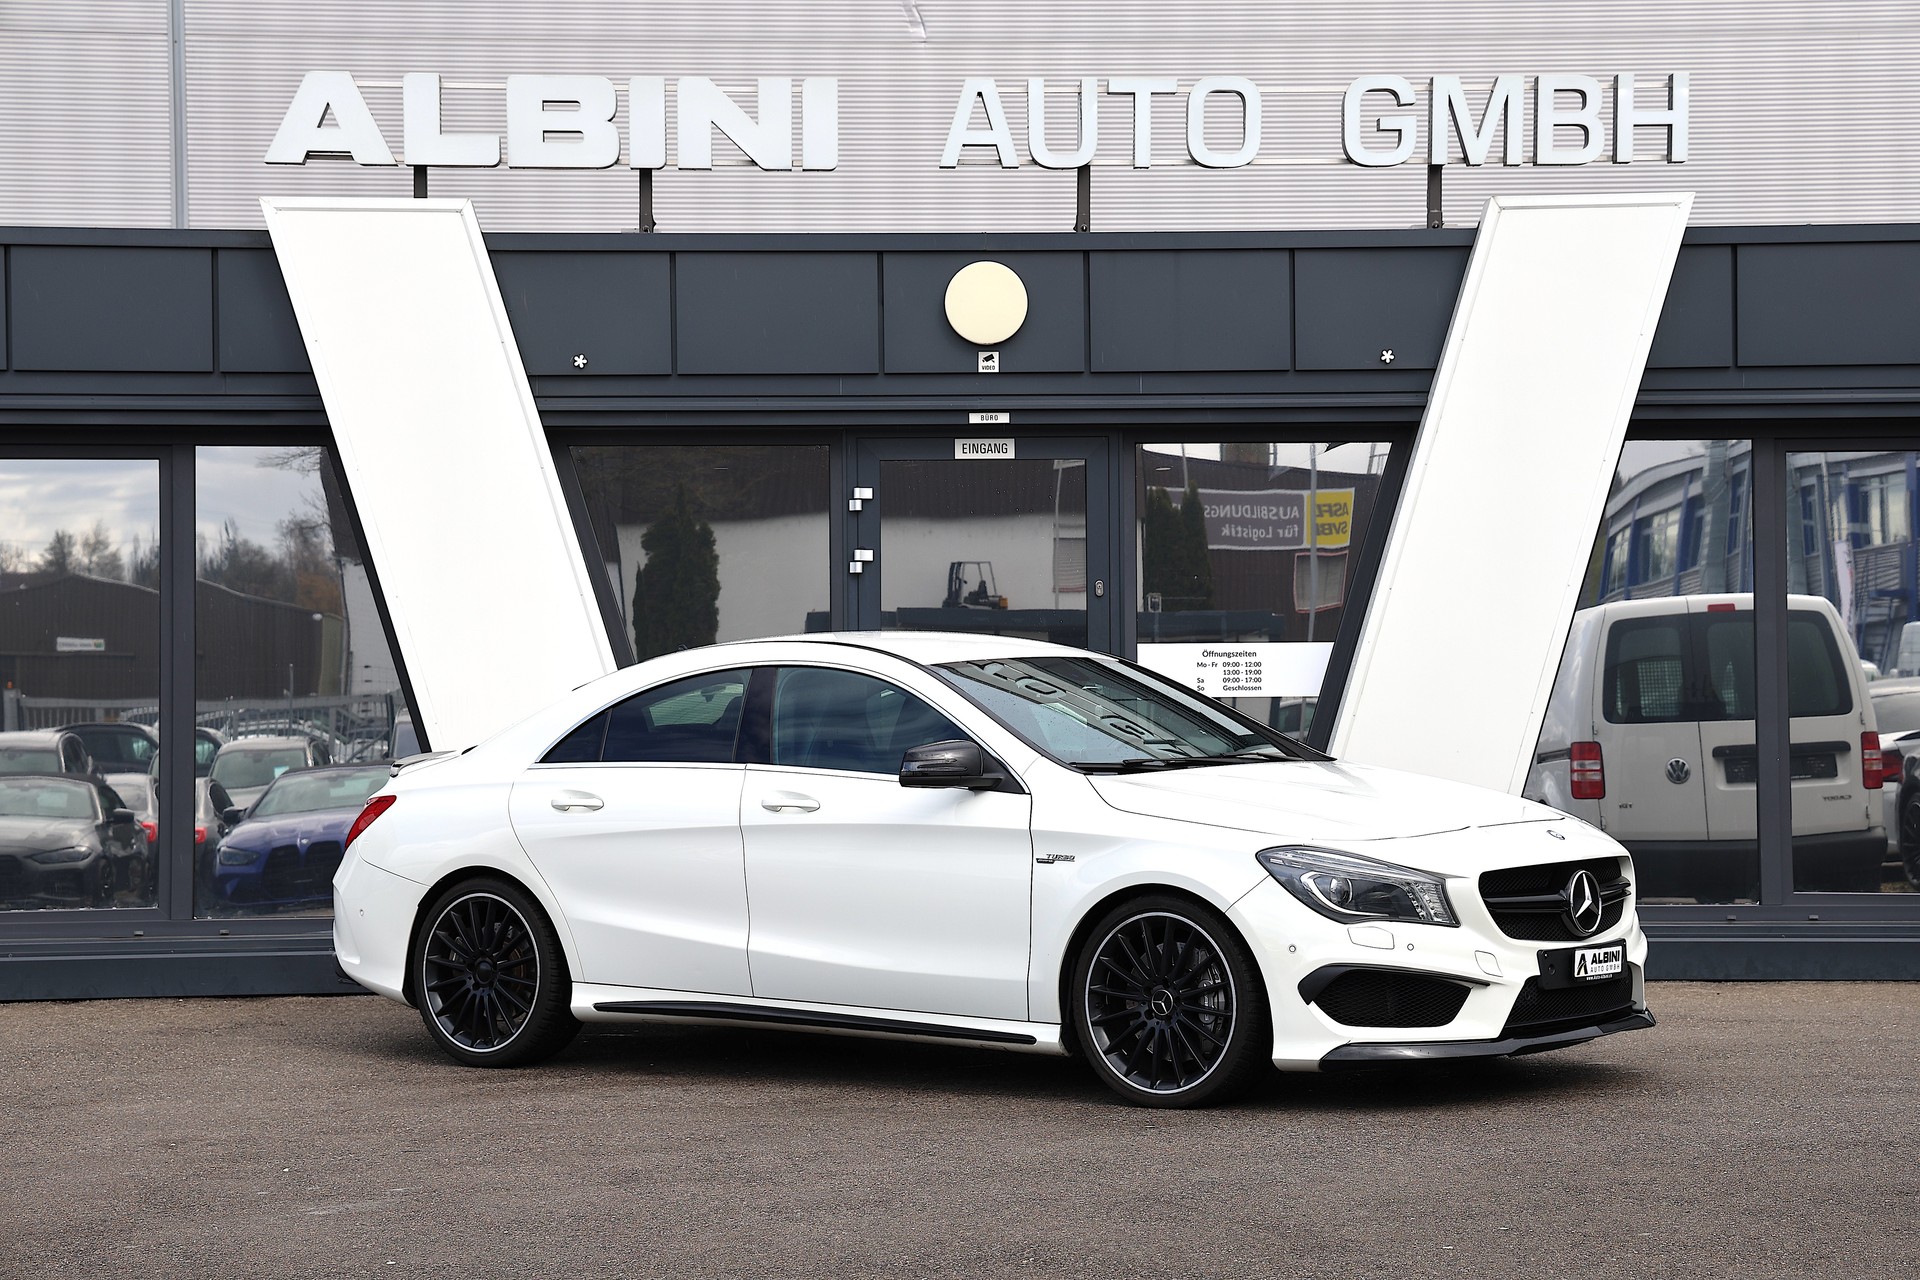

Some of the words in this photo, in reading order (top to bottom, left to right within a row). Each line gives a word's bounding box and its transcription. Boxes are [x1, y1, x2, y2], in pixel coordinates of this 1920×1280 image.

[264, 70, 839, 172] ALBINI
[939, 76, 1263, 170] AUTO
[1341, 71, 1691, 168] GMBH
[980, 414, 999, 422] BÜRO
[962, 442, 1008, 454] EINGANG
[1202, 649, 1256, 658] Öffnungszeiten
[1591, 950, 1620, 965] ALBINI
